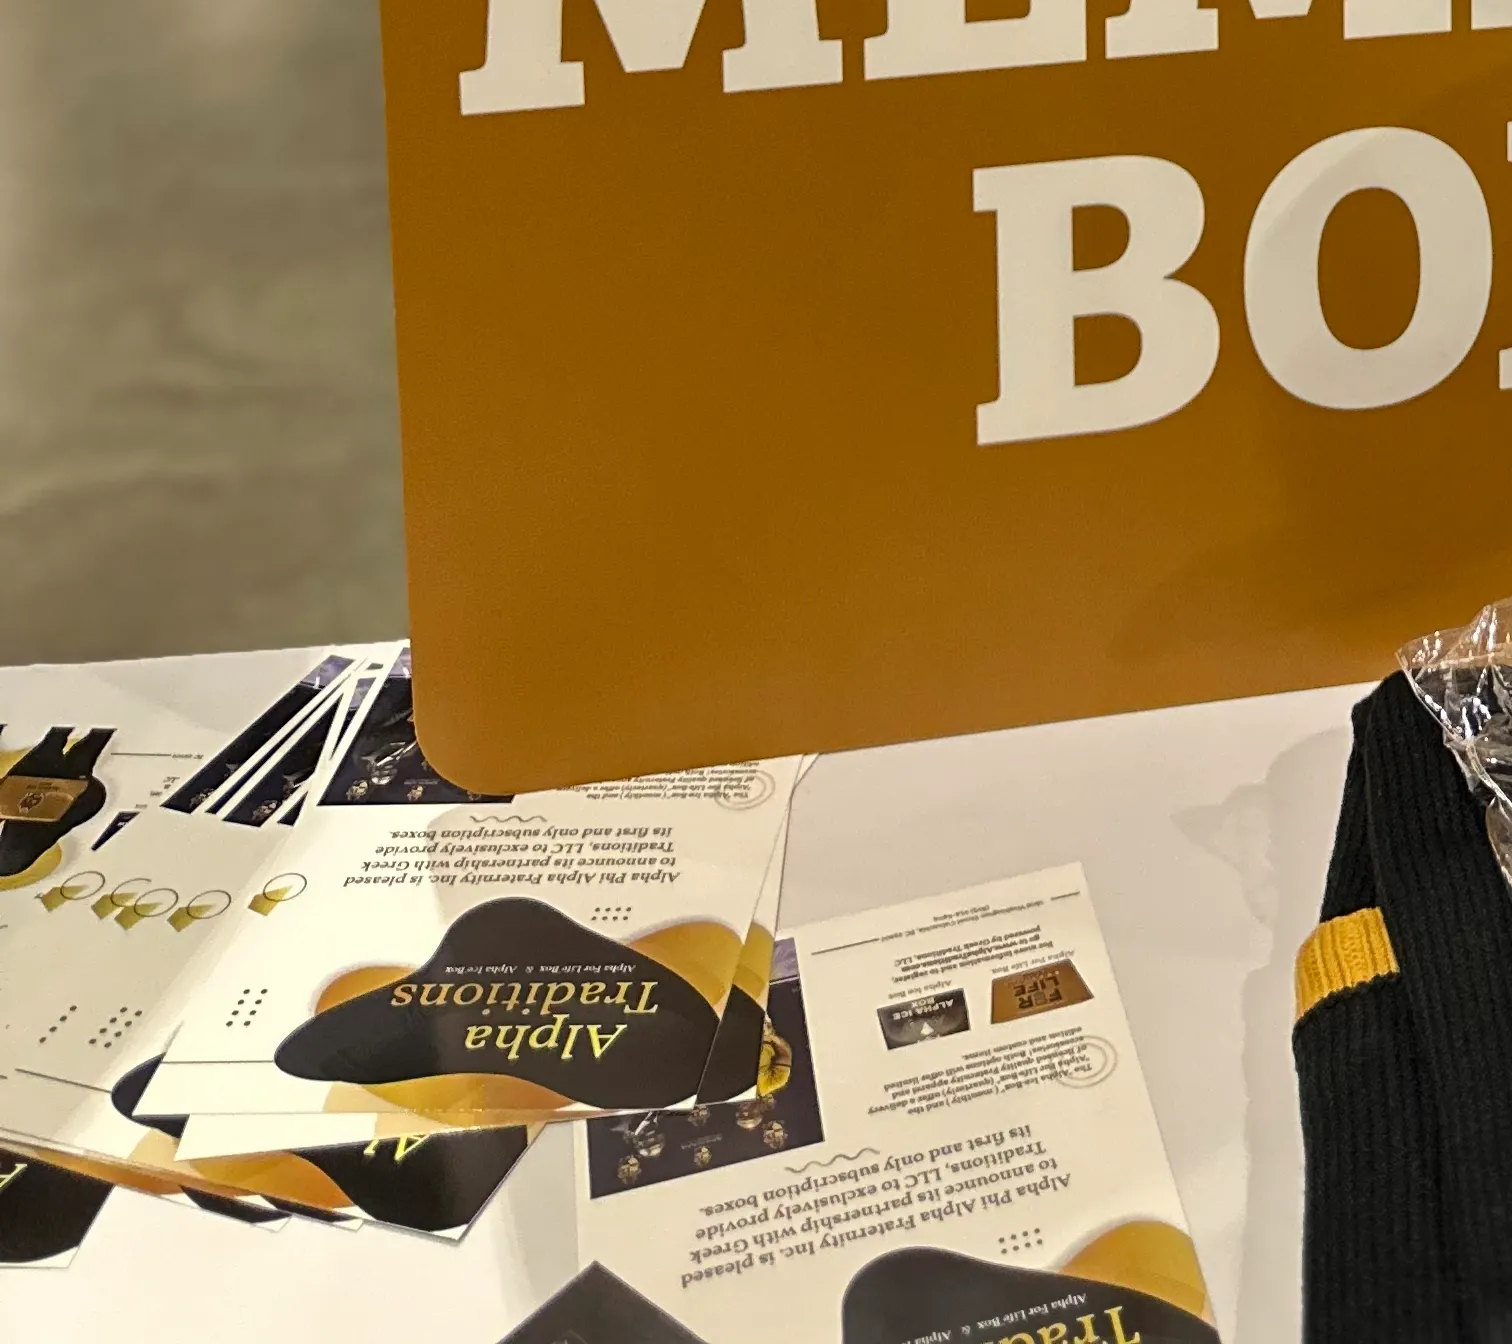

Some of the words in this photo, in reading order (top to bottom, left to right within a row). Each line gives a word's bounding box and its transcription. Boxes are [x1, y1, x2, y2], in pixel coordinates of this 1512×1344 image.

[389, 830, 436, 841] boxes.
[436, 826, 540, 841] subscription
[542, 826, 579, 840] only
[582, 828, 612, 838] and
[616, 828, 649, 838] first
[652, 827, 672, 838] its
[374, 842, 438, 856] provide
[440, 843, 528, 856] exclusively
[533, 844, 548, 854] to
[550, 843, 584, 854] LLC
[589, 841, 674, 853] Traditions,
[360, 860, 410, 872] Greek
[414, 860, 450, 872] with
[454, 856, 550, 870] partnership
[554, 858, 574, 869] its
[577, 857, 657, 867] announce
[660, 857, 676, 868] to
[343, 873, 407, 888] pleased
[410, 875, 424, 887] is
[428, 874, 457, 886] Inc.
[460, 872, 543, 885] Fraternity
[547, 870, 596, 884] Alpha
[599, 872, 627, 884] Phi
[631, 869, 680, 884] Alpha
[486, 964, 518, 974] Alpha
[584, 965, 601, 974] For
[604, 963, 636, 974] Alpha
[1014, 976, 1060, 997] LIFE
[390, 981, 658, 1015] Traditions
[912, 997, 934, 1008] BOX
[914, 999, 954, 1015] ALPHA
[893, 1010, 913, 1020] ICE
[464, 1014, 627, 1062] Alpha
[1009, 1125, 1031, 1139] its
[967, 1132, 1005, 1151] first
[928, 1143, 962, 1163] and
[946, 1142, 1047, 1173] Traditions,
[884, 1153, 925, 1172] only
[1039, 1158, 1058, 1170] to
[763, 1164, 880, 1202] subscription
[882, 1179, 900, 1191] to
[905, 1168, 942, 1189] LLC
[945, 1164, 1034, 1195] announce
[1016, 1174, 1071, 1196] Alpha
[917, 1189, 941, 1202] its
[981, 1190, 1012, 1210] Phi
[700, 1195, 759, 1216] boxes.
[774, 1185, 877, 1221] exclusively
[801, 1191, 913, 1234] partnership
[920, 1199, 976, 1222] Alpha
[696, 1208, 770, 1240] provide
[752, 1227, 797, 1248] with
[820, 1215, 917, 1249] Fraternity
[690, 1239, 749, 1265] Greek
[780, 1241, 815, 1258] Inc.
[759, 1252, 775, 1266] is
[681, 1253, 754, 1289] pleased
[1051, 1294, 1086, 1309] Alpha
[1003, 1310, 1026, 1323] Life
[1028, 1304, 1049, 1316] For
[976, 1317, 1004, 1329] Box
[960, 1325, 971, 1336] &
